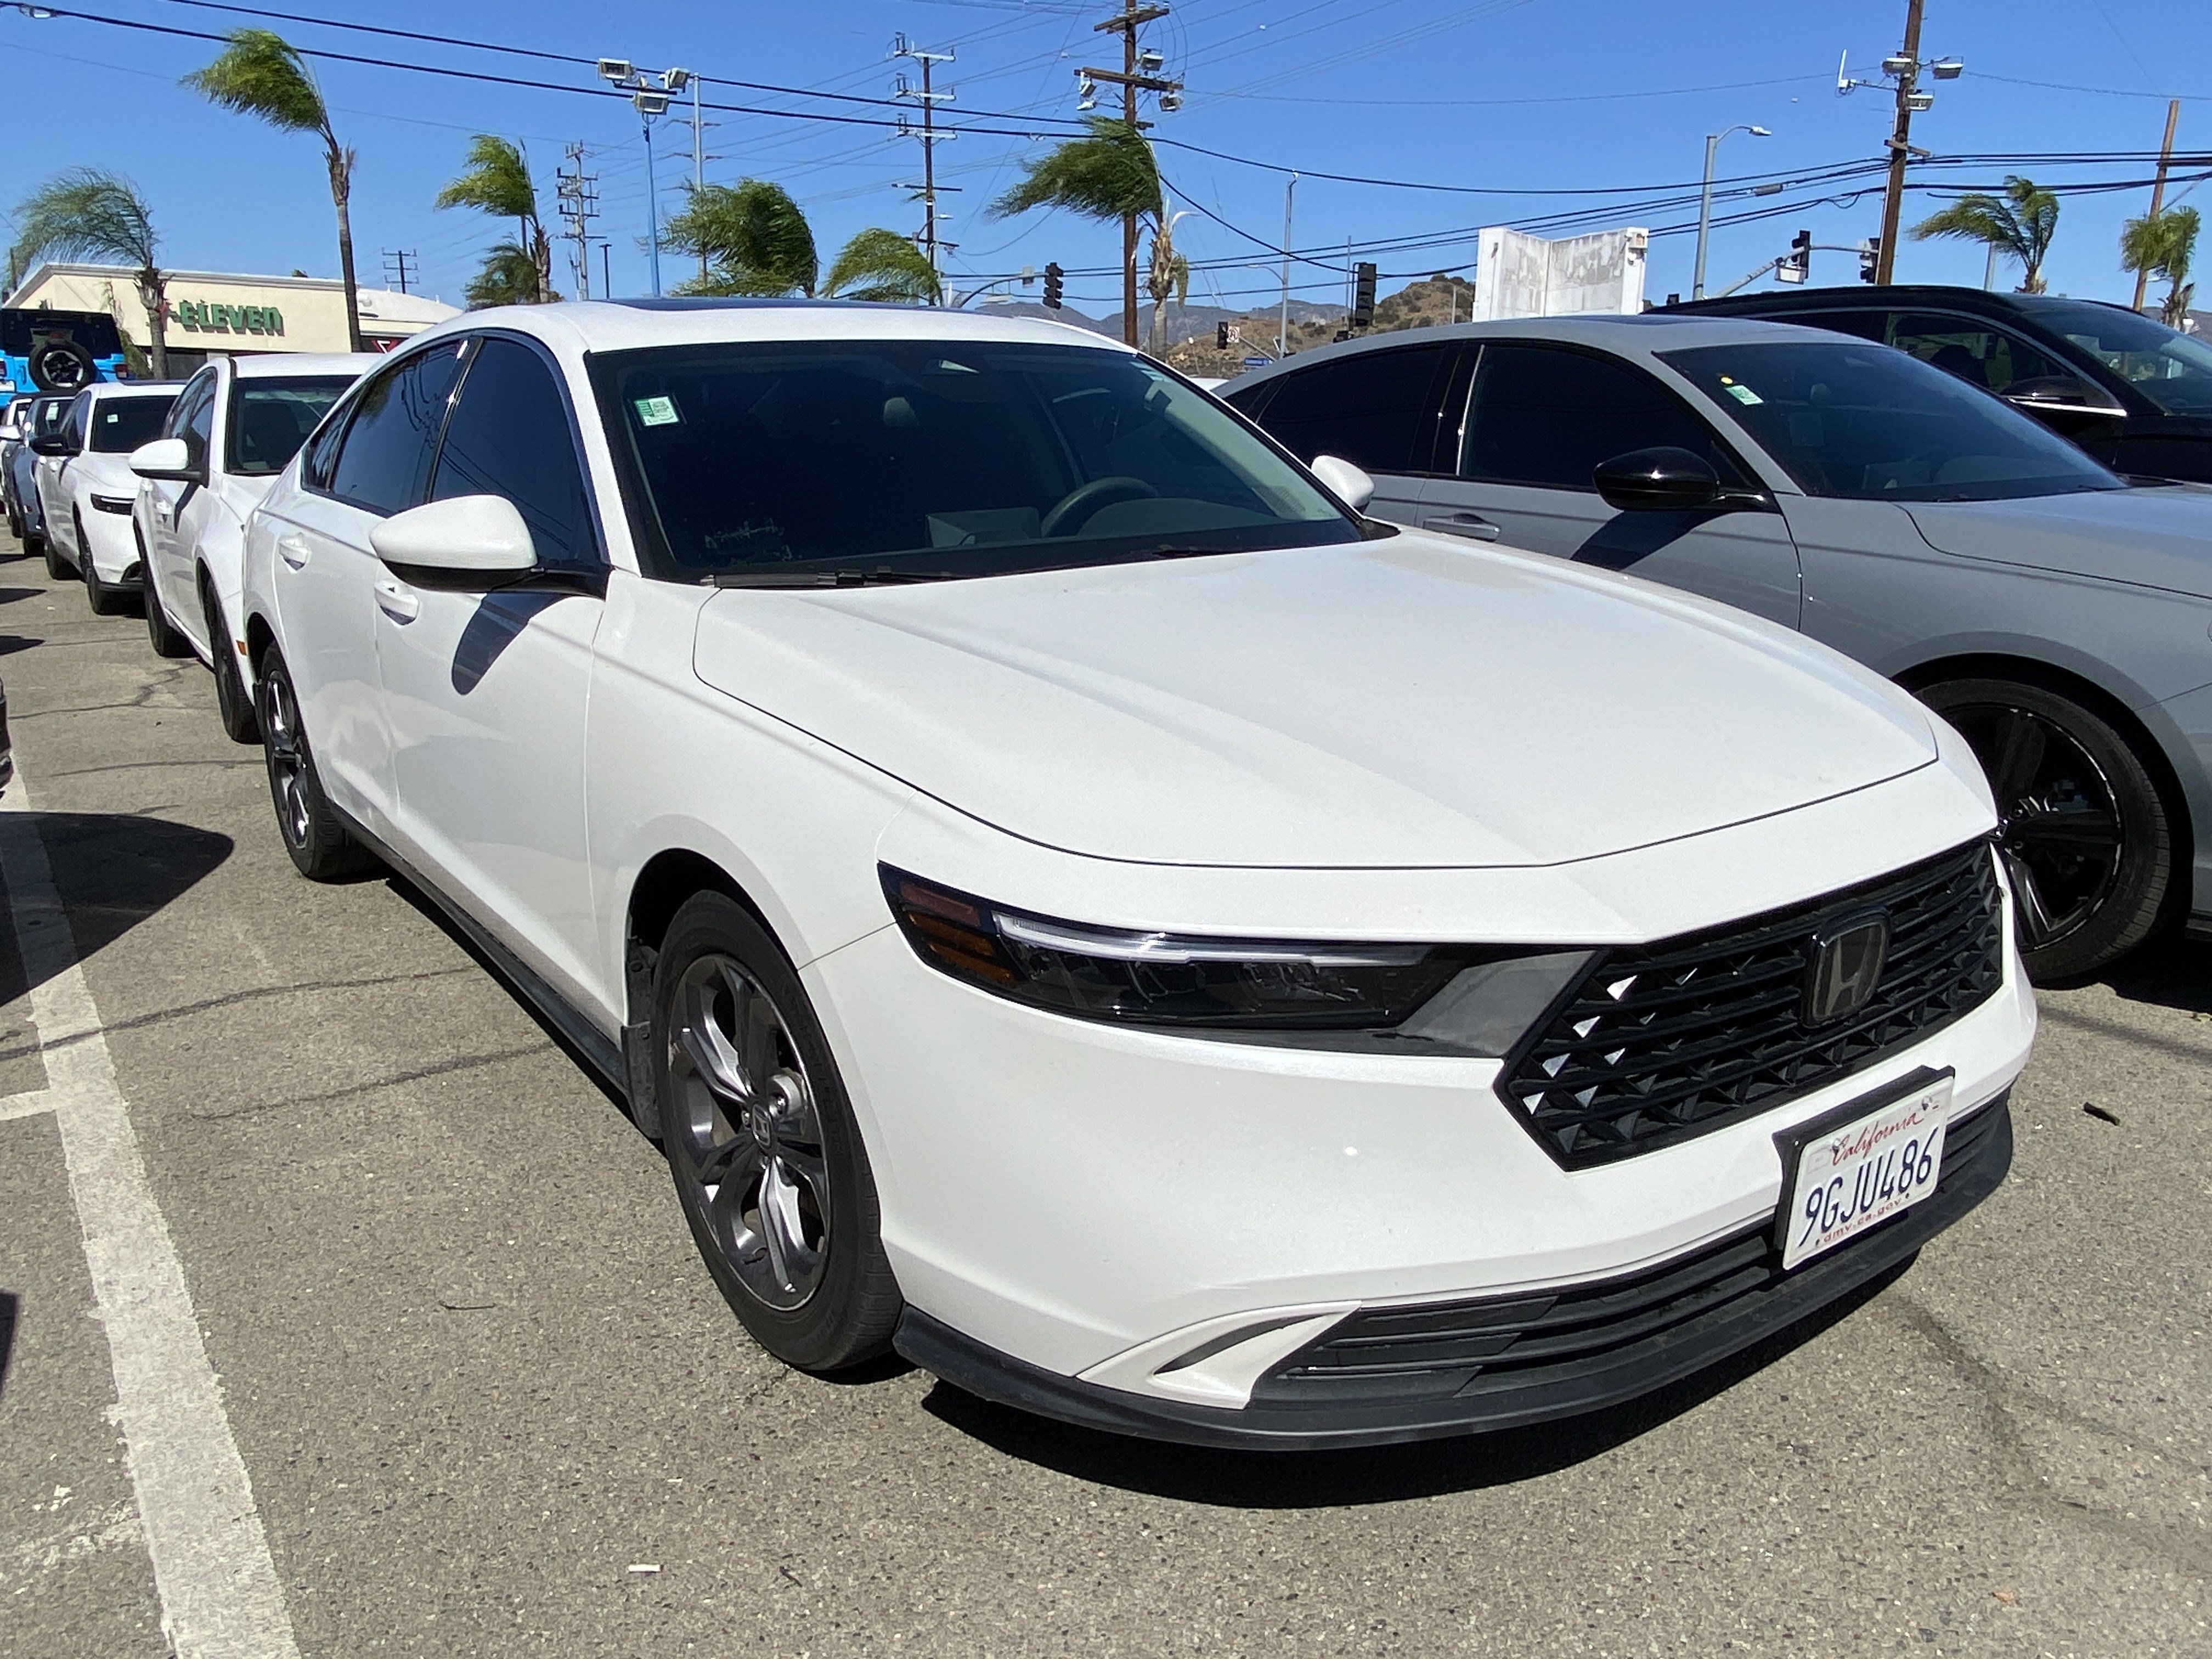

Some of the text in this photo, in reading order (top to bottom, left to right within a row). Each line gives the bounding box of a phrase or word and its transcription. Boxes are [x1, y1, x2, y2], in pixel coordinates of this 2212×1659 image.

[1831, 1110, 1925, 1166] California
[1798, 1126, 1939, 1248] 9GJU486
[1824, 1199, 1902, 1243] dmv.ca.gov
